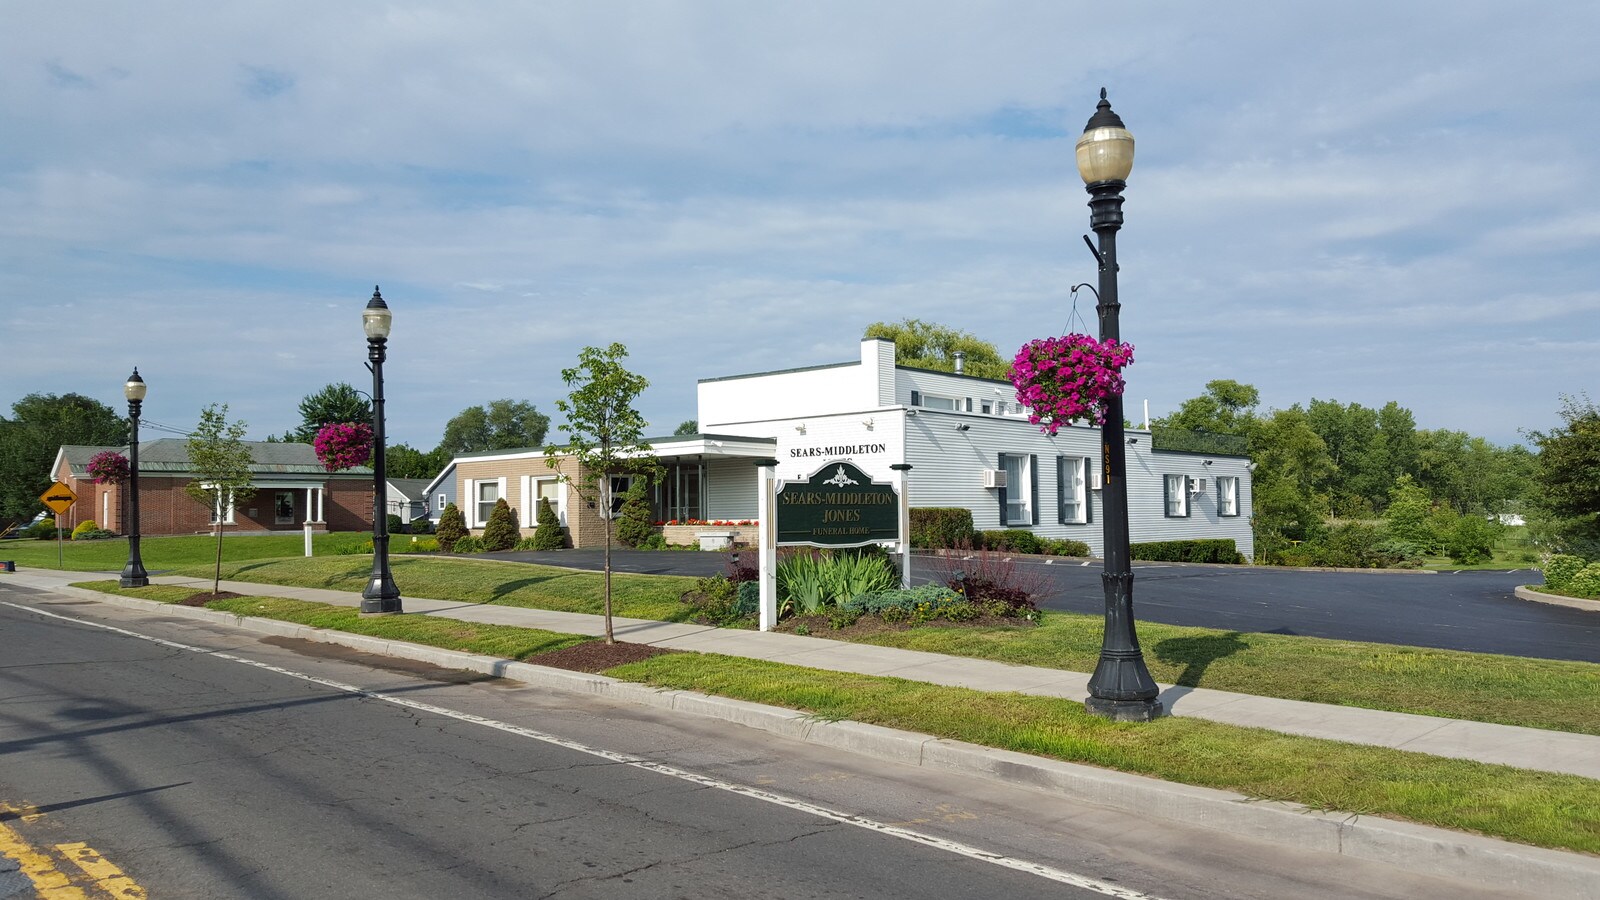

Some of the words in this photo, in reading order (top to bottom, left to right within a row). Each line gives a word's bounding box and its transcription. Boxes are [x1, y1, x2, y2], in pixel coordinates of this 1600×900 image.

[790, 443, 886, 458] SEARS-MIDDLETON
[782, 492, 893, 505] SEARS-MIDDLETON
[822, 508, 861, 524] JONES
[812, 527, 848, 536] FUNERAL
[849, 526, 870, 535] HOME
